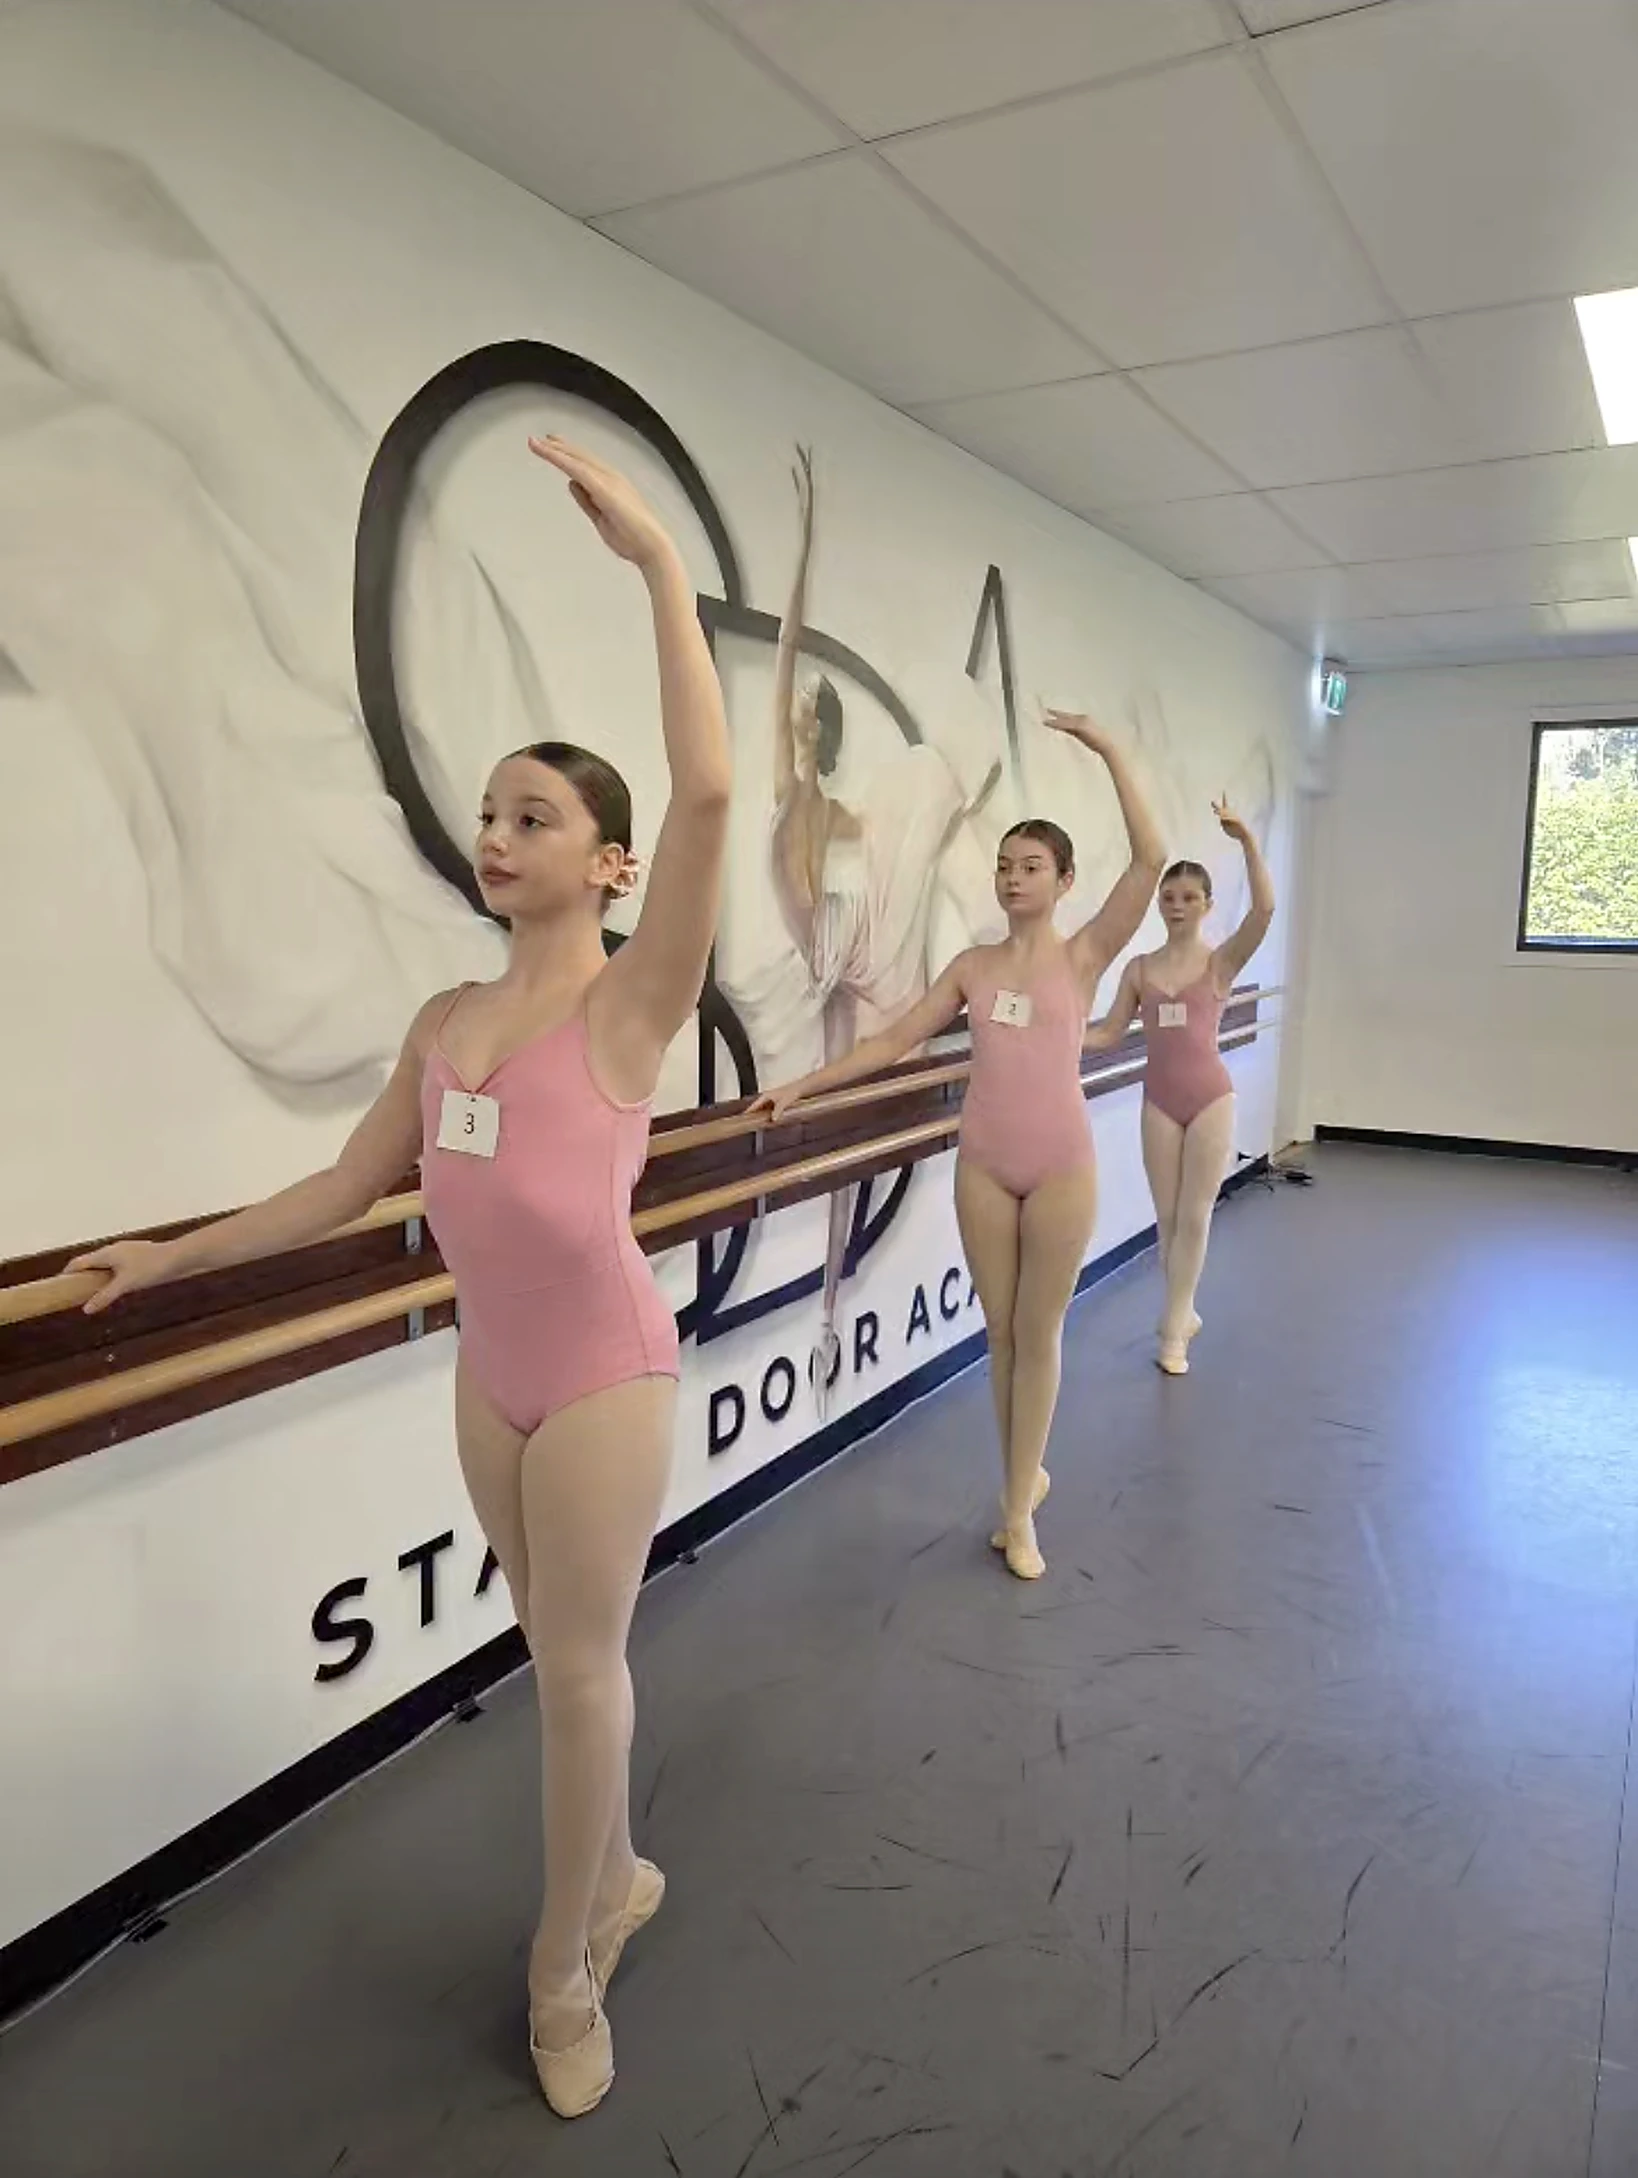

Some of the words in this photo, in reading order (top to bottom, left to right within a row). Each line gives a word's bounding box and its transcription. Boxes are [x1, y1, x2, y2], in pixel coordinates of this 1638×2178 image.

[1008, 1002, 1017, 1016] 2
[463, 1112, 475, 1135] 3
[707, 1310, 881, 1457] DOOR
[905, 1266, 985, 1346] AC
